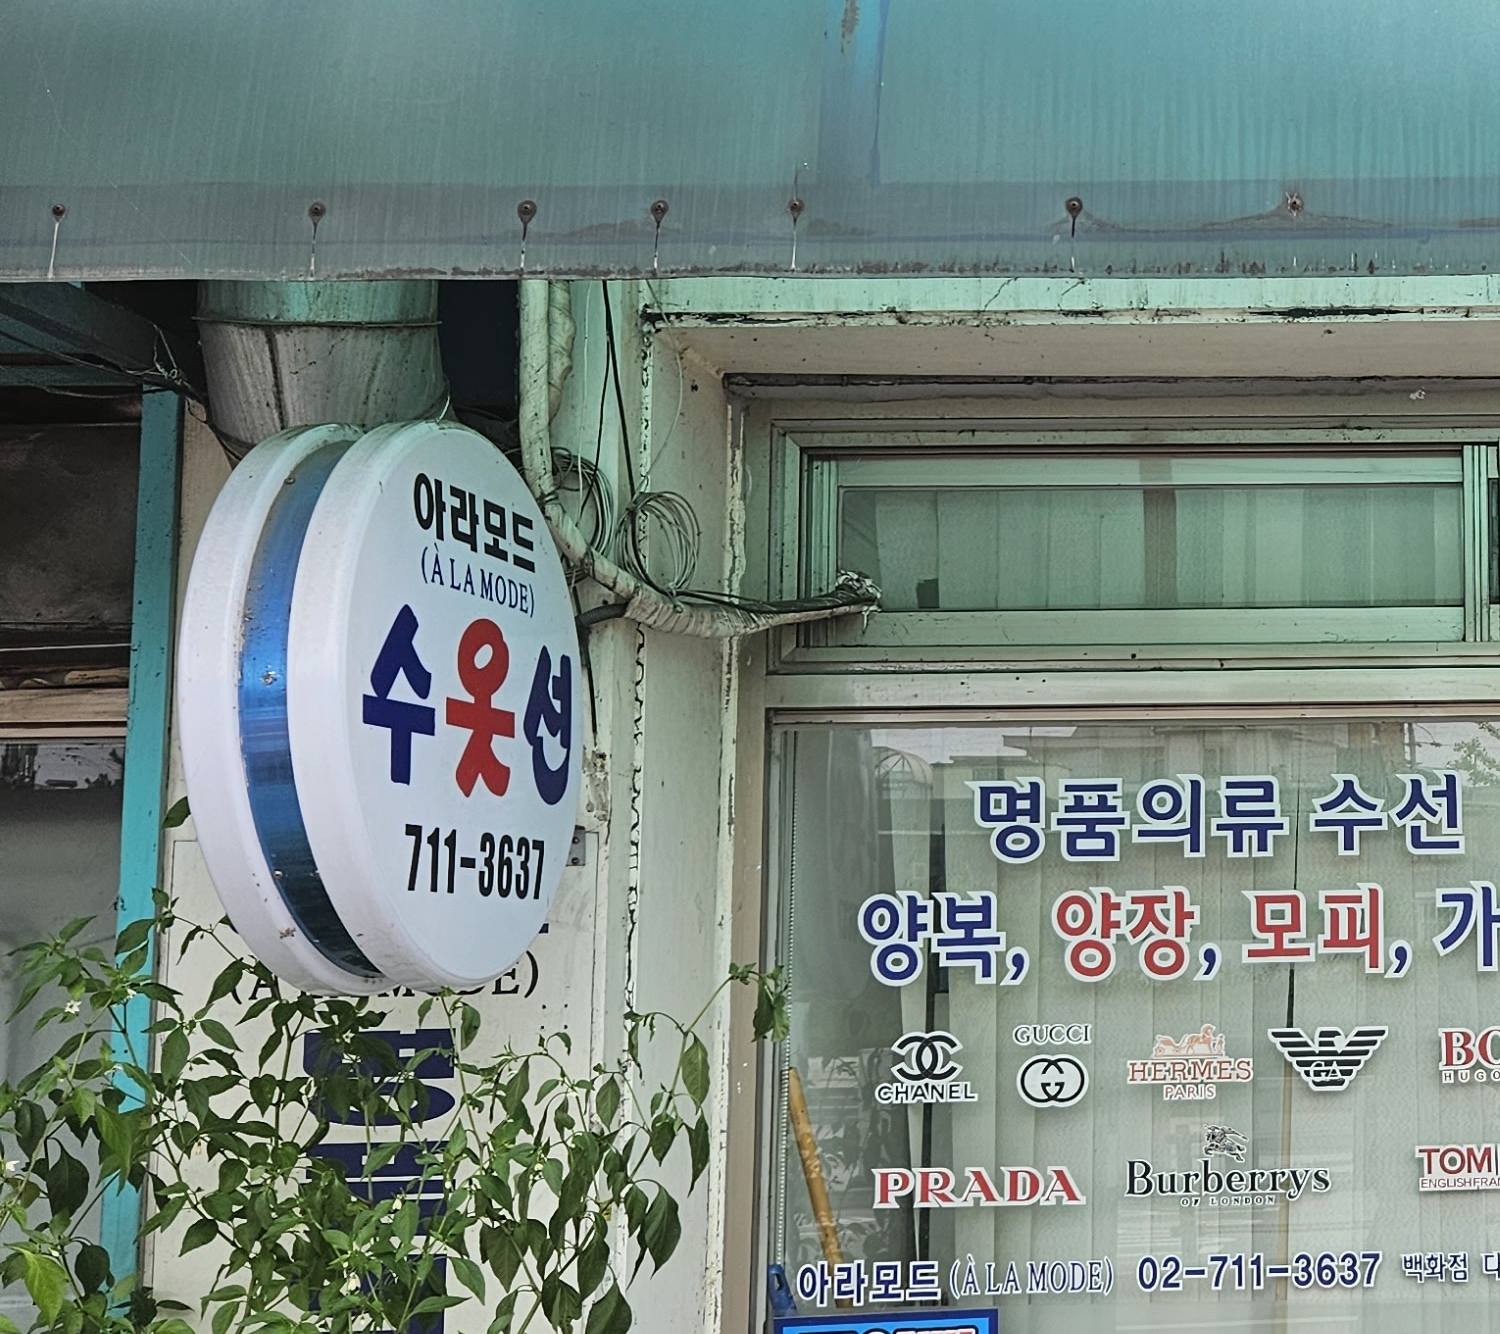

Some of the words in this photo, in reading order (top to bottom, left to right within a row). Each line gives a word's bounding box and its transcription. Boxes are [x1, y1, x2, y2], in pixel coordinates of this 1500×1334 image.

[414, 473, 535, 573] 아라모드
[450, 558, 475, 594] LA
[481, 569, 535, 618] MODE)
[969, 774, 1288, 863] 명품의류
[1311, 772, 1465, 855] 수선
[405, 824, 545, 901] 711-3637
[860, 891, 1028, 985] 양복,
[1053, 887, 1219, 981] 양장,
[1243, 883, 1411, 977] 모피,
[1013, 1025, 1091, 1044] GUCCI
[1128, 1059, 1252, 1082] HERMES
[877, 1082, 977, 1103] CHANEL
[1164, 1084, 1216, 1100] PARIS
[874, 1167, 1083, 1207] PRADA
[1125, 1159, 1331, 1200] Burberrys
[1210, 1195, 1276, 1206] LONDON
[797, 1260, 942, 1308] 아라모드
[985, 1263, 1023, 1296] LA
[1027, 1258, 1115, 1296] MODE)
[1137, 1251, 1382, 1291] 02-711-3637
[1401, 1252, 1470, 1282] 백화점
